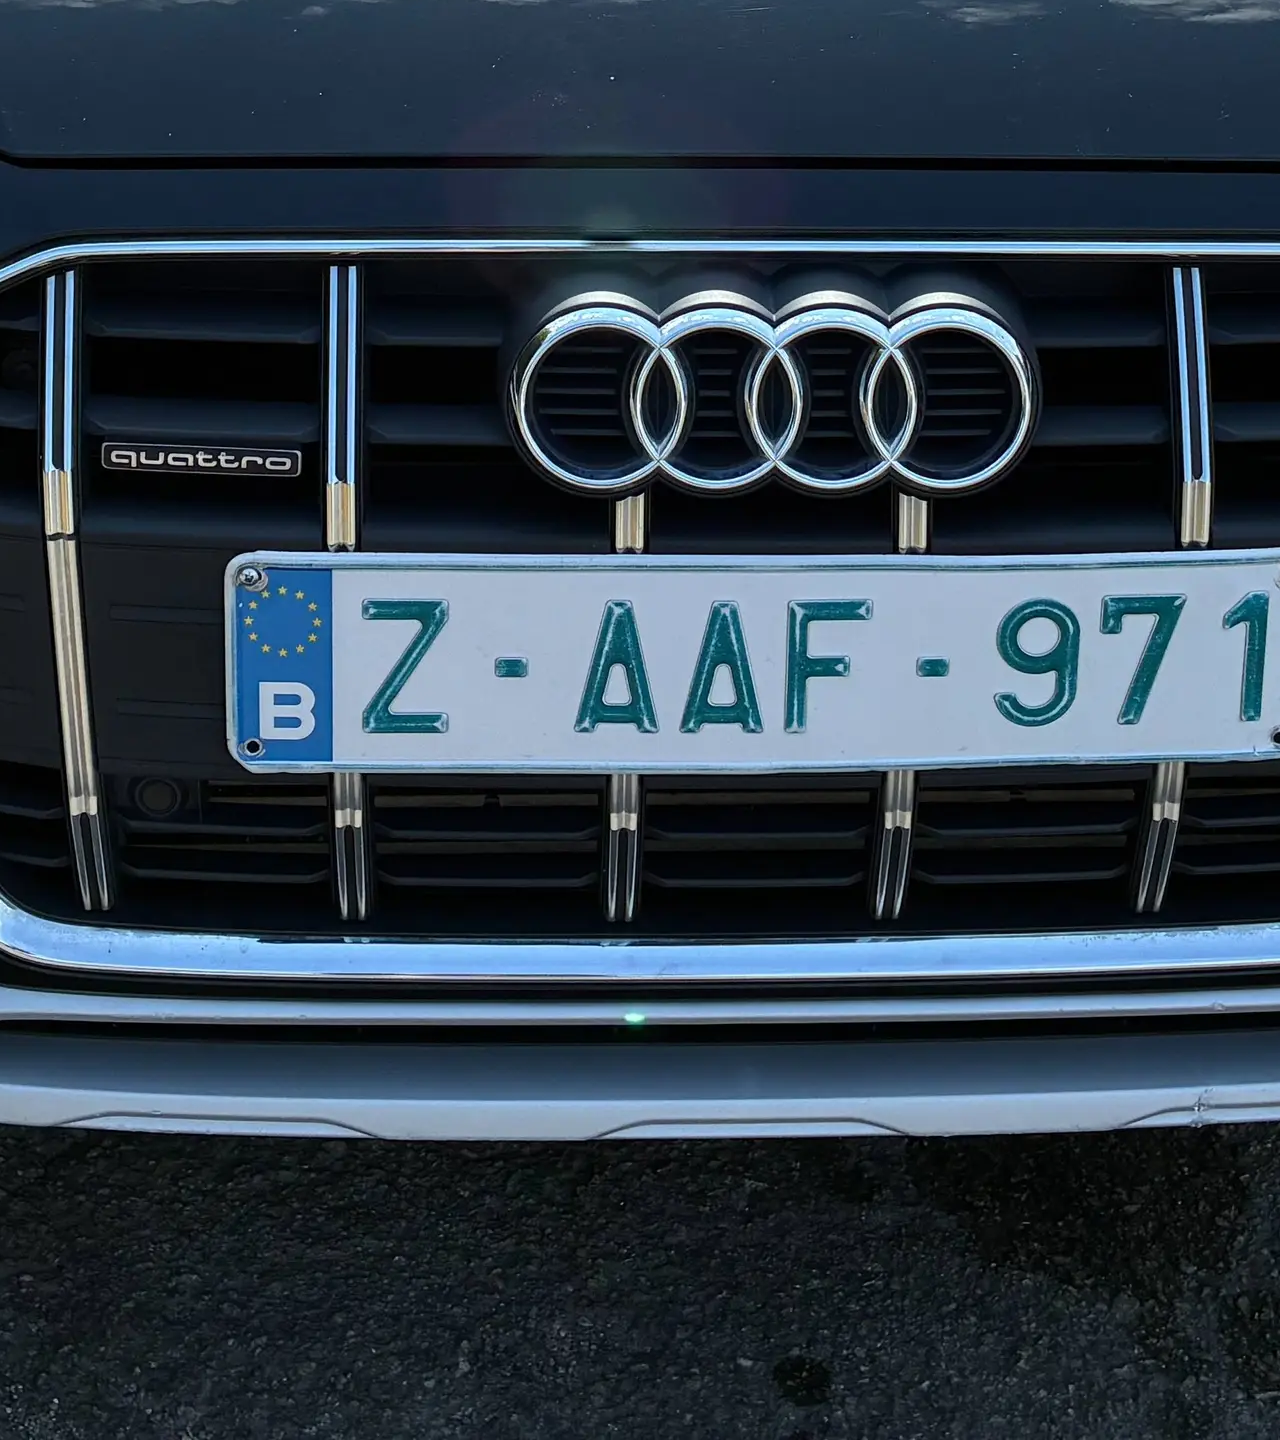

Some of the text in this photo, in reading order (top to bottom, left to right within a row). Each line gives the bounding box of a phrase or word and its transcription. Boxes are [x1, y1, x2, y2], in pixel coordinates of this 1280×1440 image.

[110, 450, 292, 471] quattro
[361, 591, 1270, 735] Z-AAF-971
[258, 681, 315, 741] B
